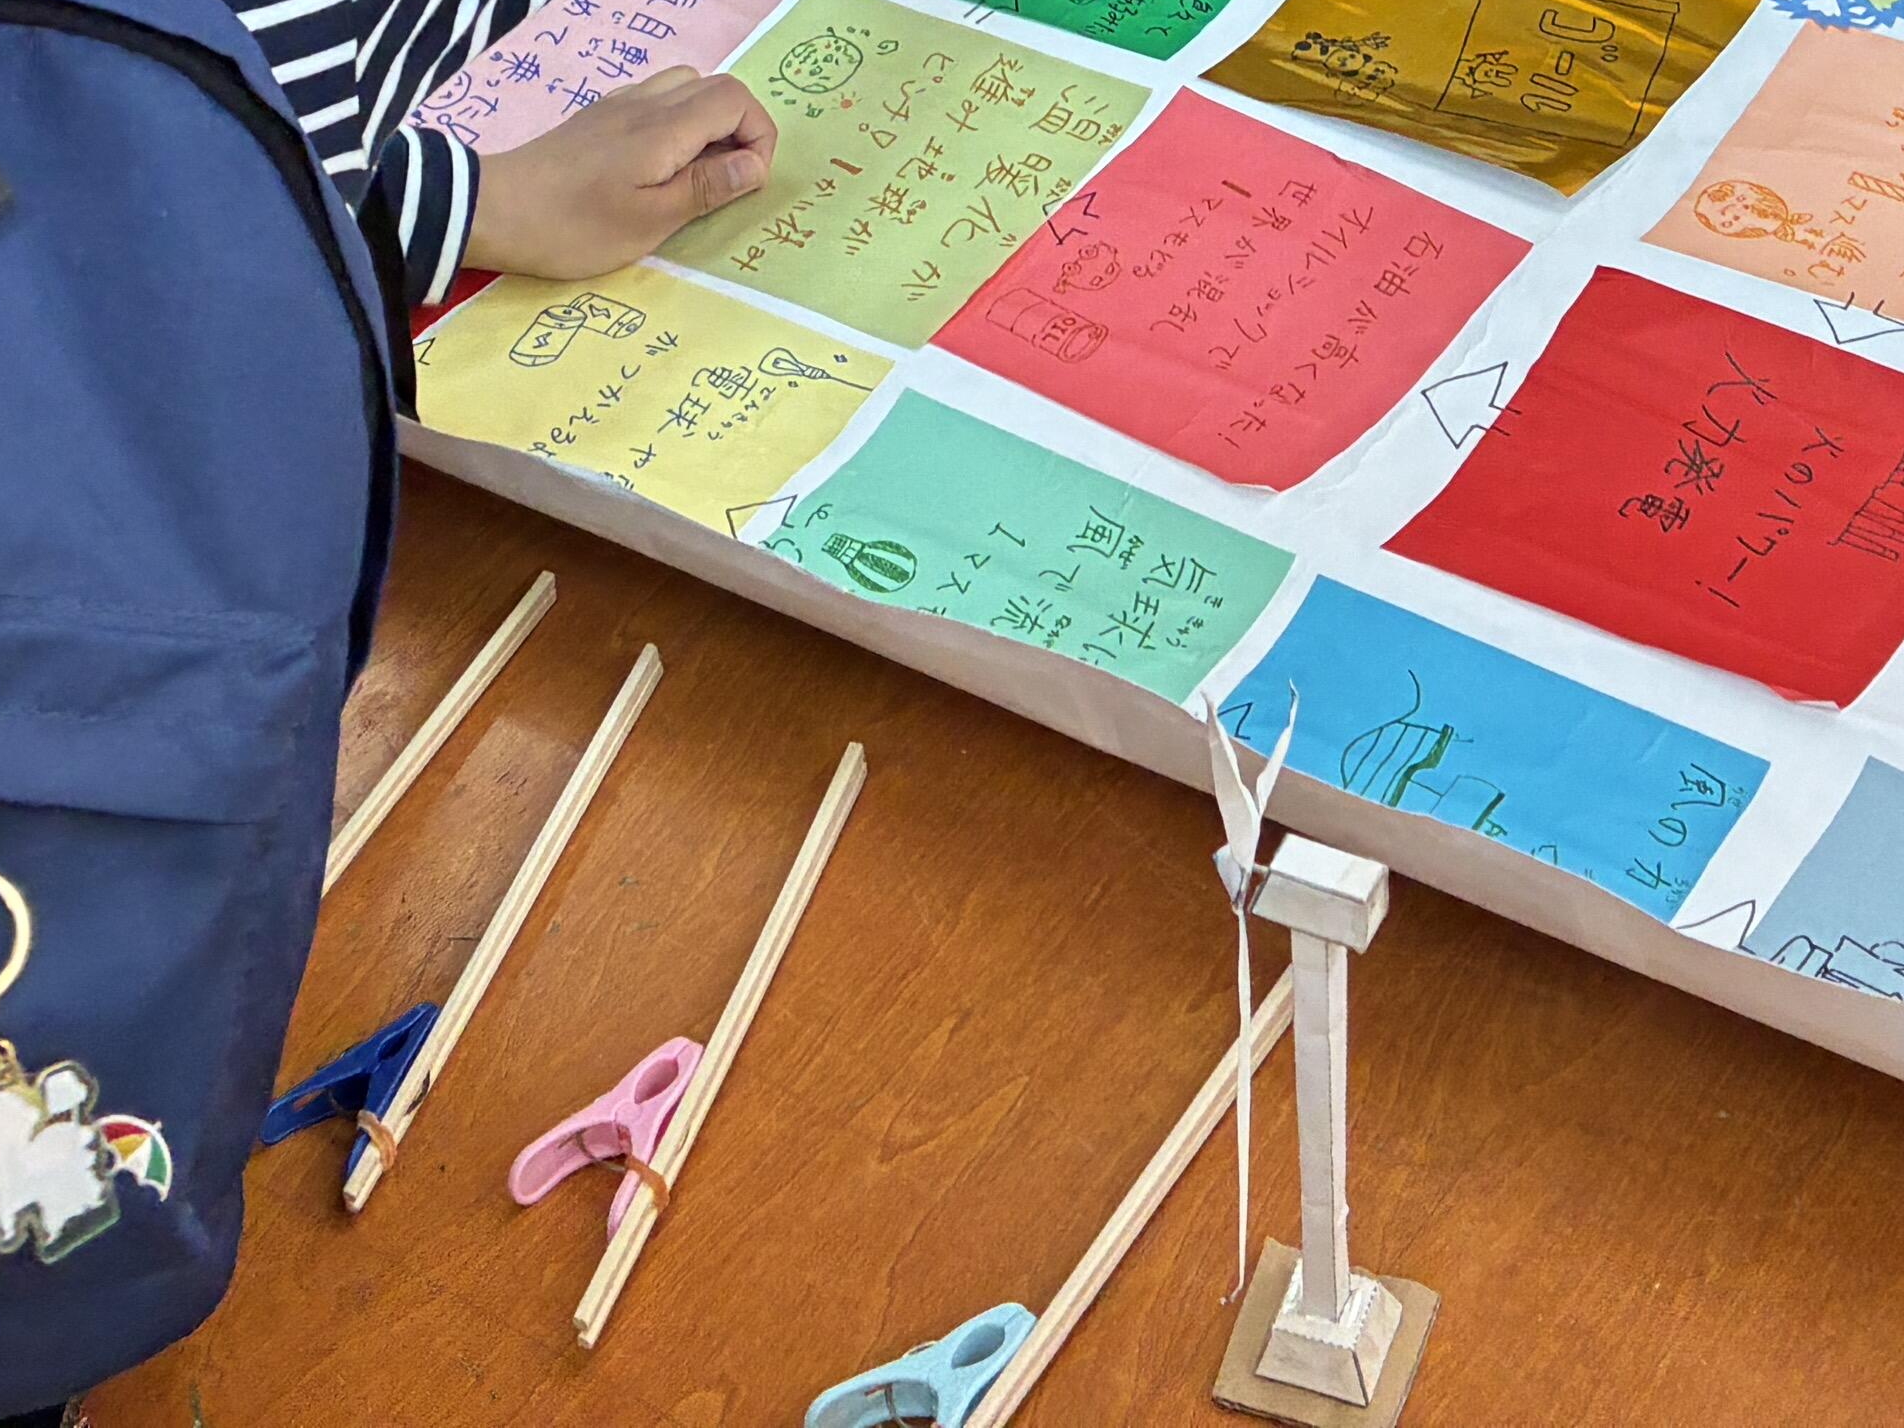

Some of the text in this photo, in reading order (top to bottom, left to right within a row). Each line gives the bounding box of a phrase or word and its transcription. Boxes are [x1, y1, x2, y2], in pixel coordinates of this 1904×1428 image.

[1514, 9, 1621, 119] ゴール
[832, 53, 1027, 258] 進み地球が
[895, 81, 1114, 305] 温暖化が
[1040, 312, 1079, 347] OIL
[1147, 175, 1320, 339] 世界が混乱
[1205, 200, 1380, 371] オイルショックで
[1216, 228, 1449, 450] 石油が高くなった!
[1614, 351, 1791, 538] 火力発電
[1691, 425, 1851, 608] 火のパワー!
[1615, 760, 1739, 896] 風の力
